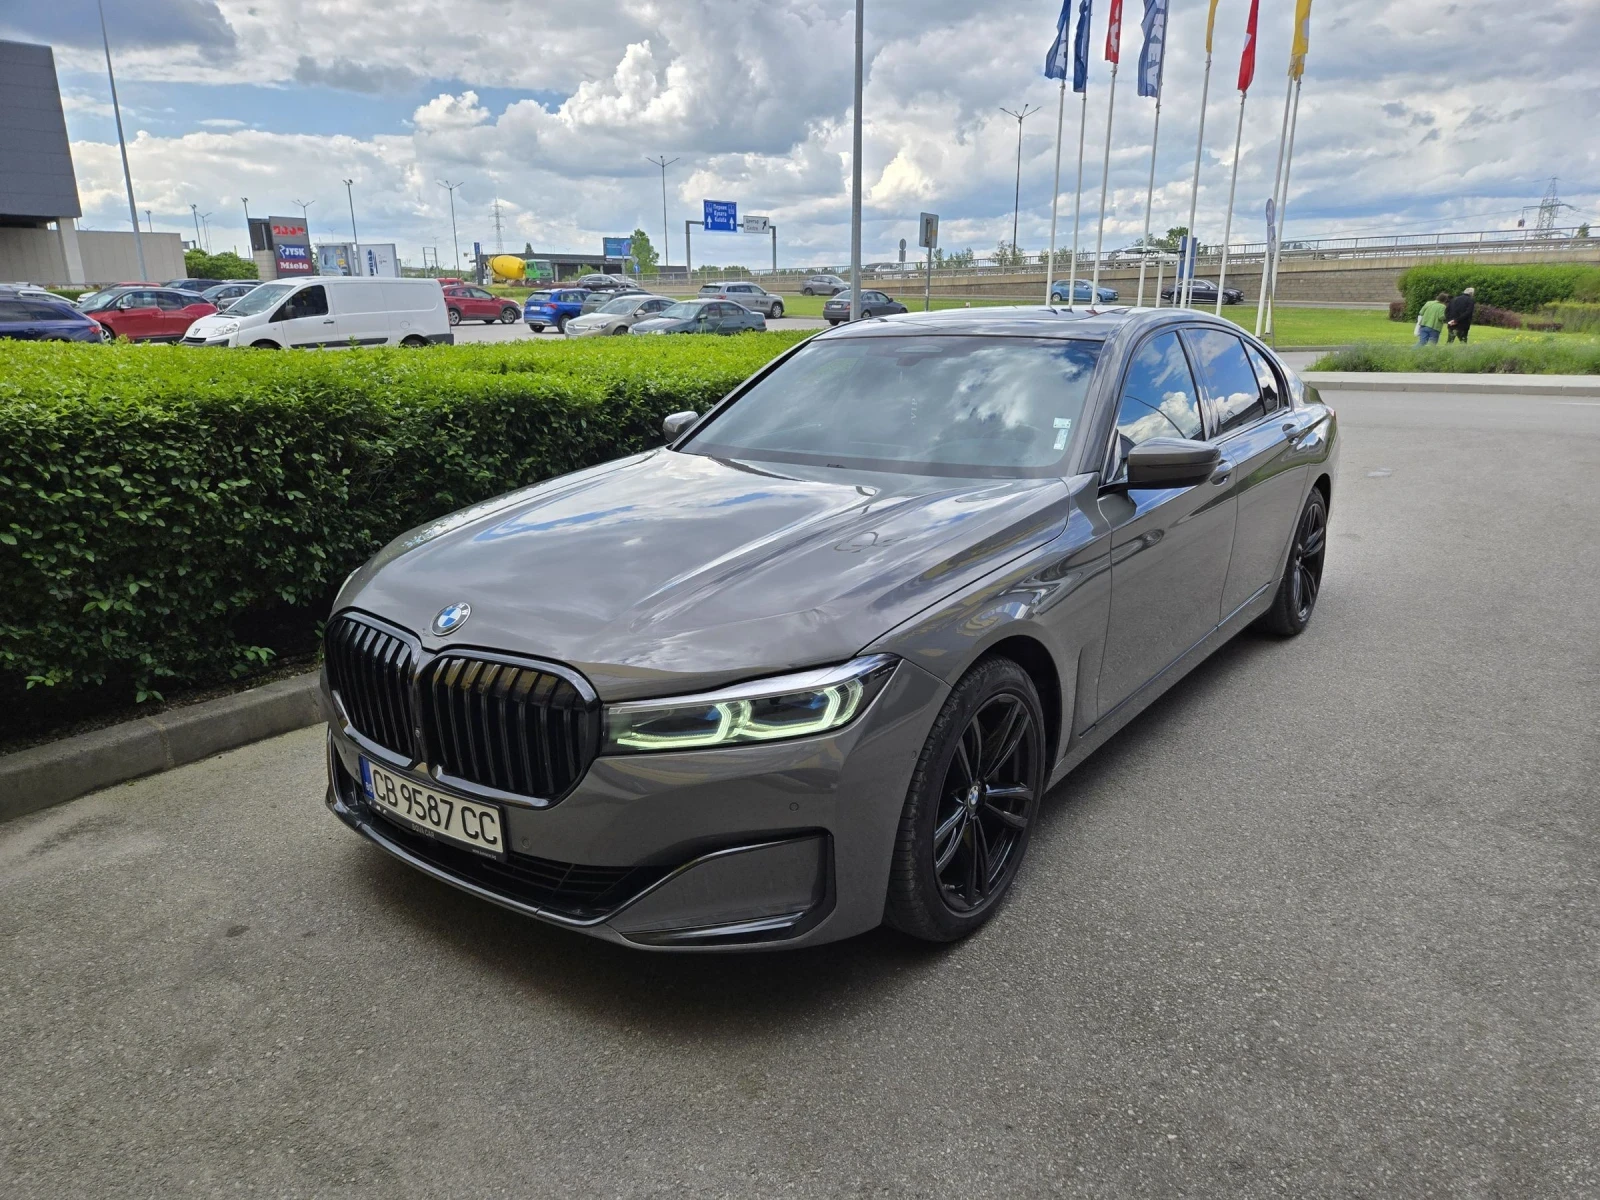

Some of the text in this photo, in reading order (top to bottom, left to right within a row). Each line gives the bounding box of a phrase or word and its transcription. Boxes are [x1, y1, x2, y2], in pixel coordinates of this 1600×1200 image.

[285, 247, 305, 256] JYSK
[280, 261, 309, 269] Miele
[373, 769, 498, 845] CB 9587 CC
